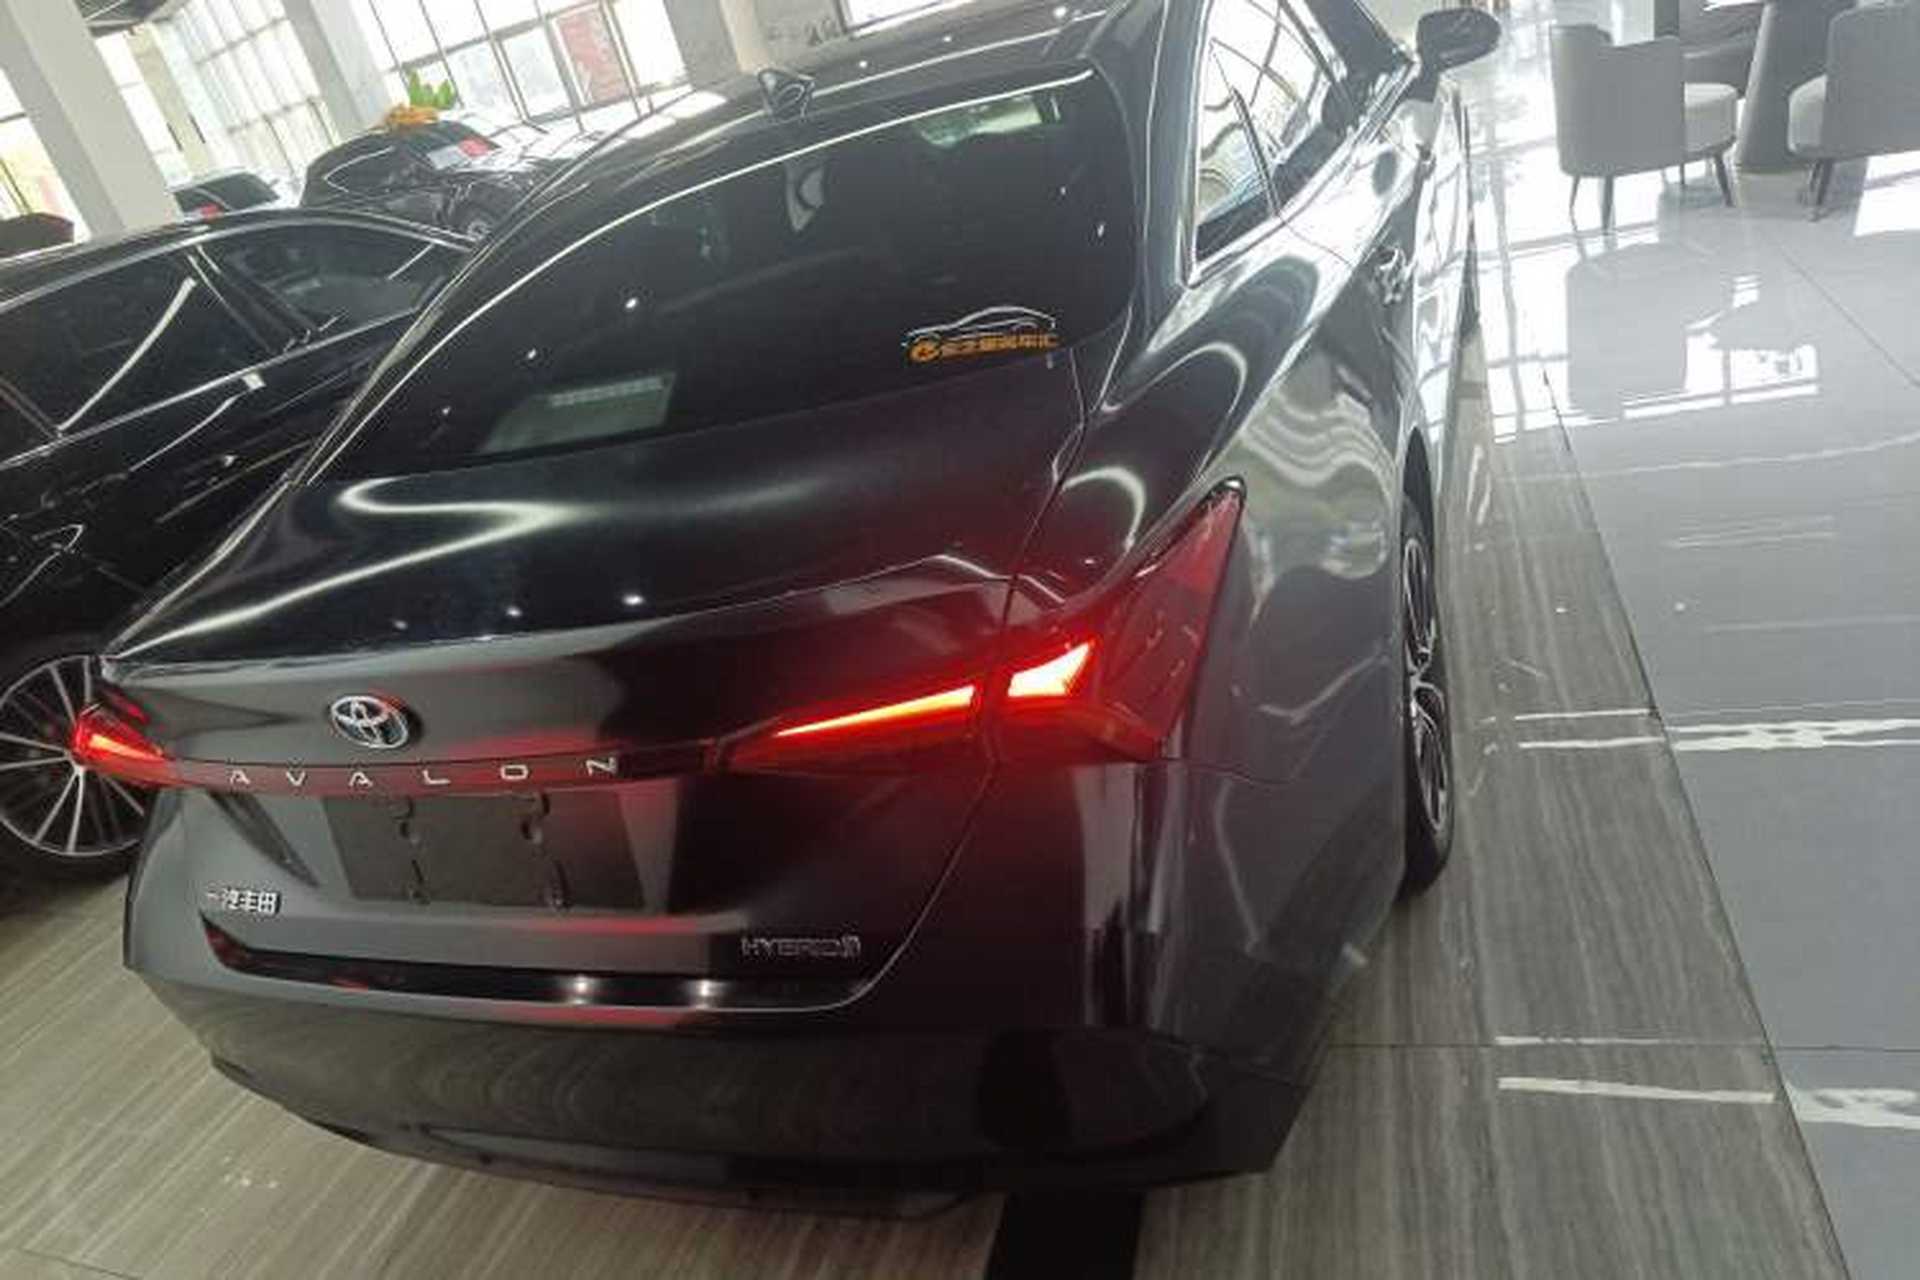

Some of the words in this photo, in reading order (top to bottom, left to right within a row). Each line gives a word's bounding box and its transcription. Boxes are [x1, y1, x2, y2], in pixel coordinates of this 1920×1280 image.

[229, 756, 618, 787] AVALON
[207, 888, 280, 913] 一汽丰田
[741, 937, 841, 957] HYBRID
